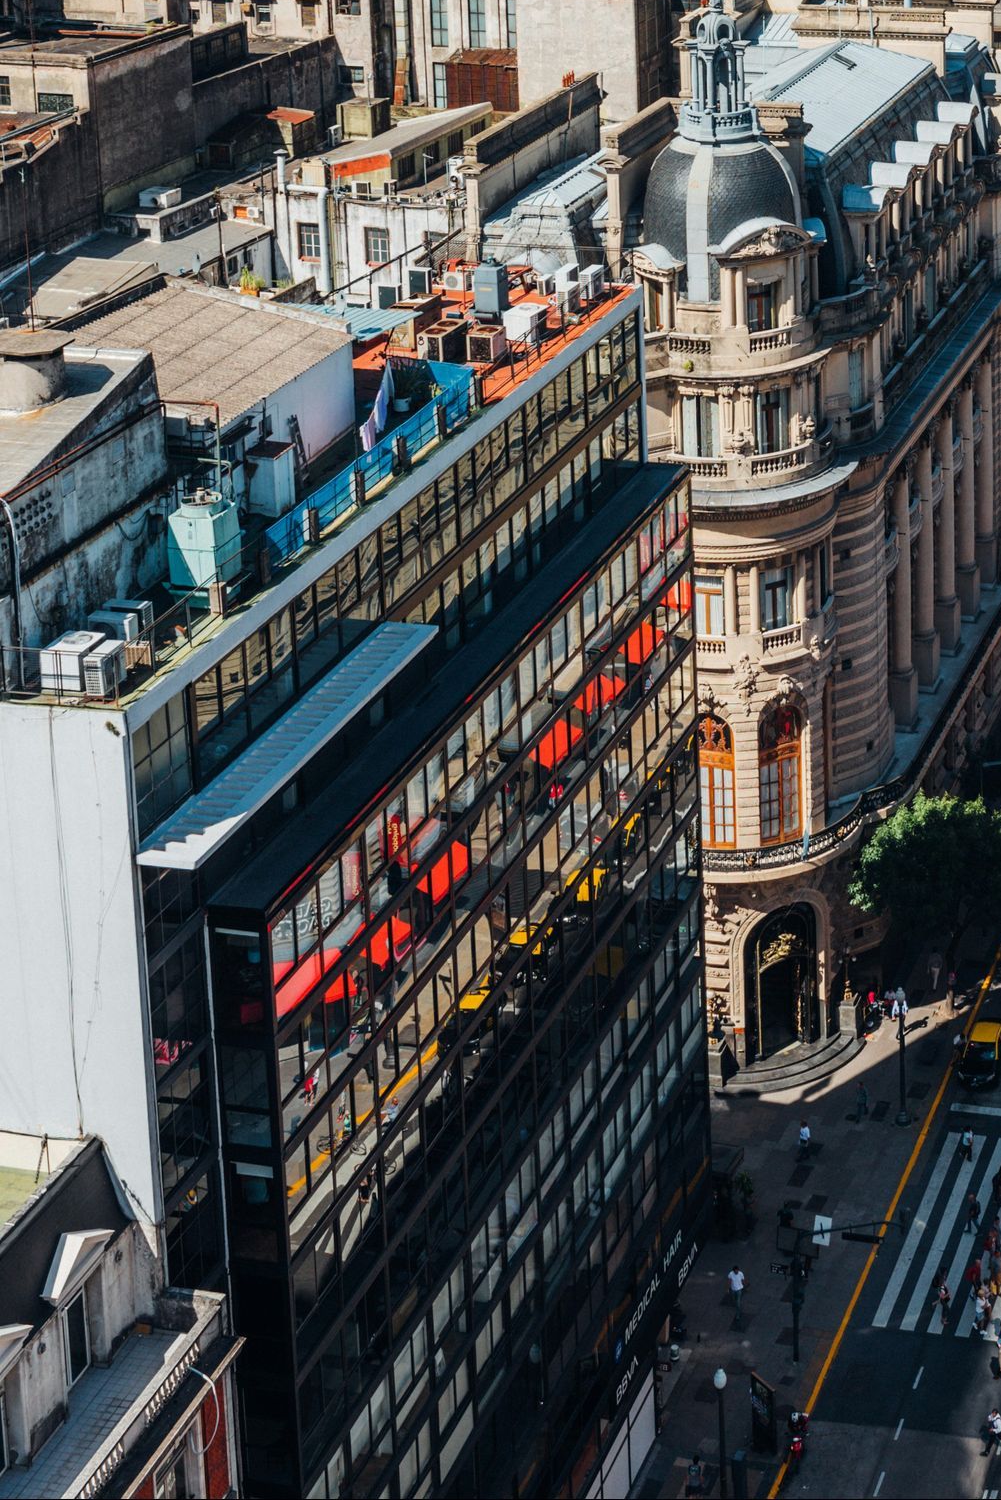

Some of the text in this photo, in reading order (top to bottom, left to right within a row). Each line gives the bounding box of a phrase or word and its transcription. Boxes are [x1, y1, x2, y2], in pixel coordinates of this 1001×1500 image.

[624, 1229, 683, 1345] MEDICAL HAIR
[678, 1241, 698, 1288] BBVA
[615, 1355, 639, 1405] BBVA
